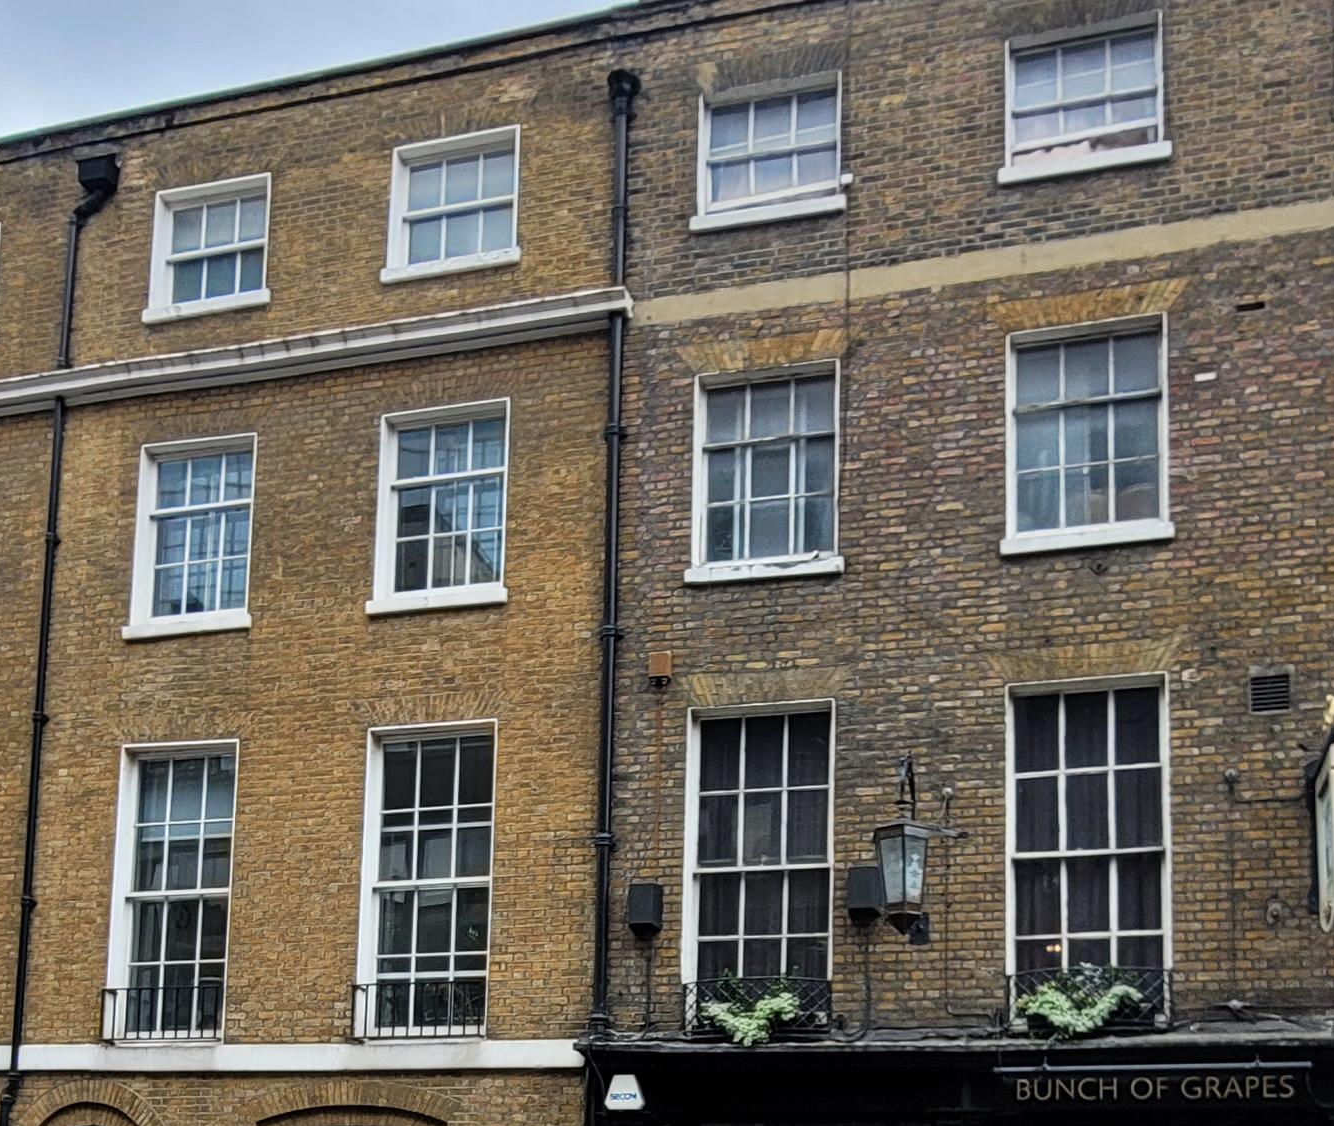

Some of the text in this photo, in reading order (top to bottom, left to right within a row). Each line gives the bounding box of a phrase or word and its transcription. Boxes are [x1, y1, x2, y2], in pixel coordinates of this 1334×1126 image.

[1016, 1075, 1296, 1100] BUNCH OF GRAPES
